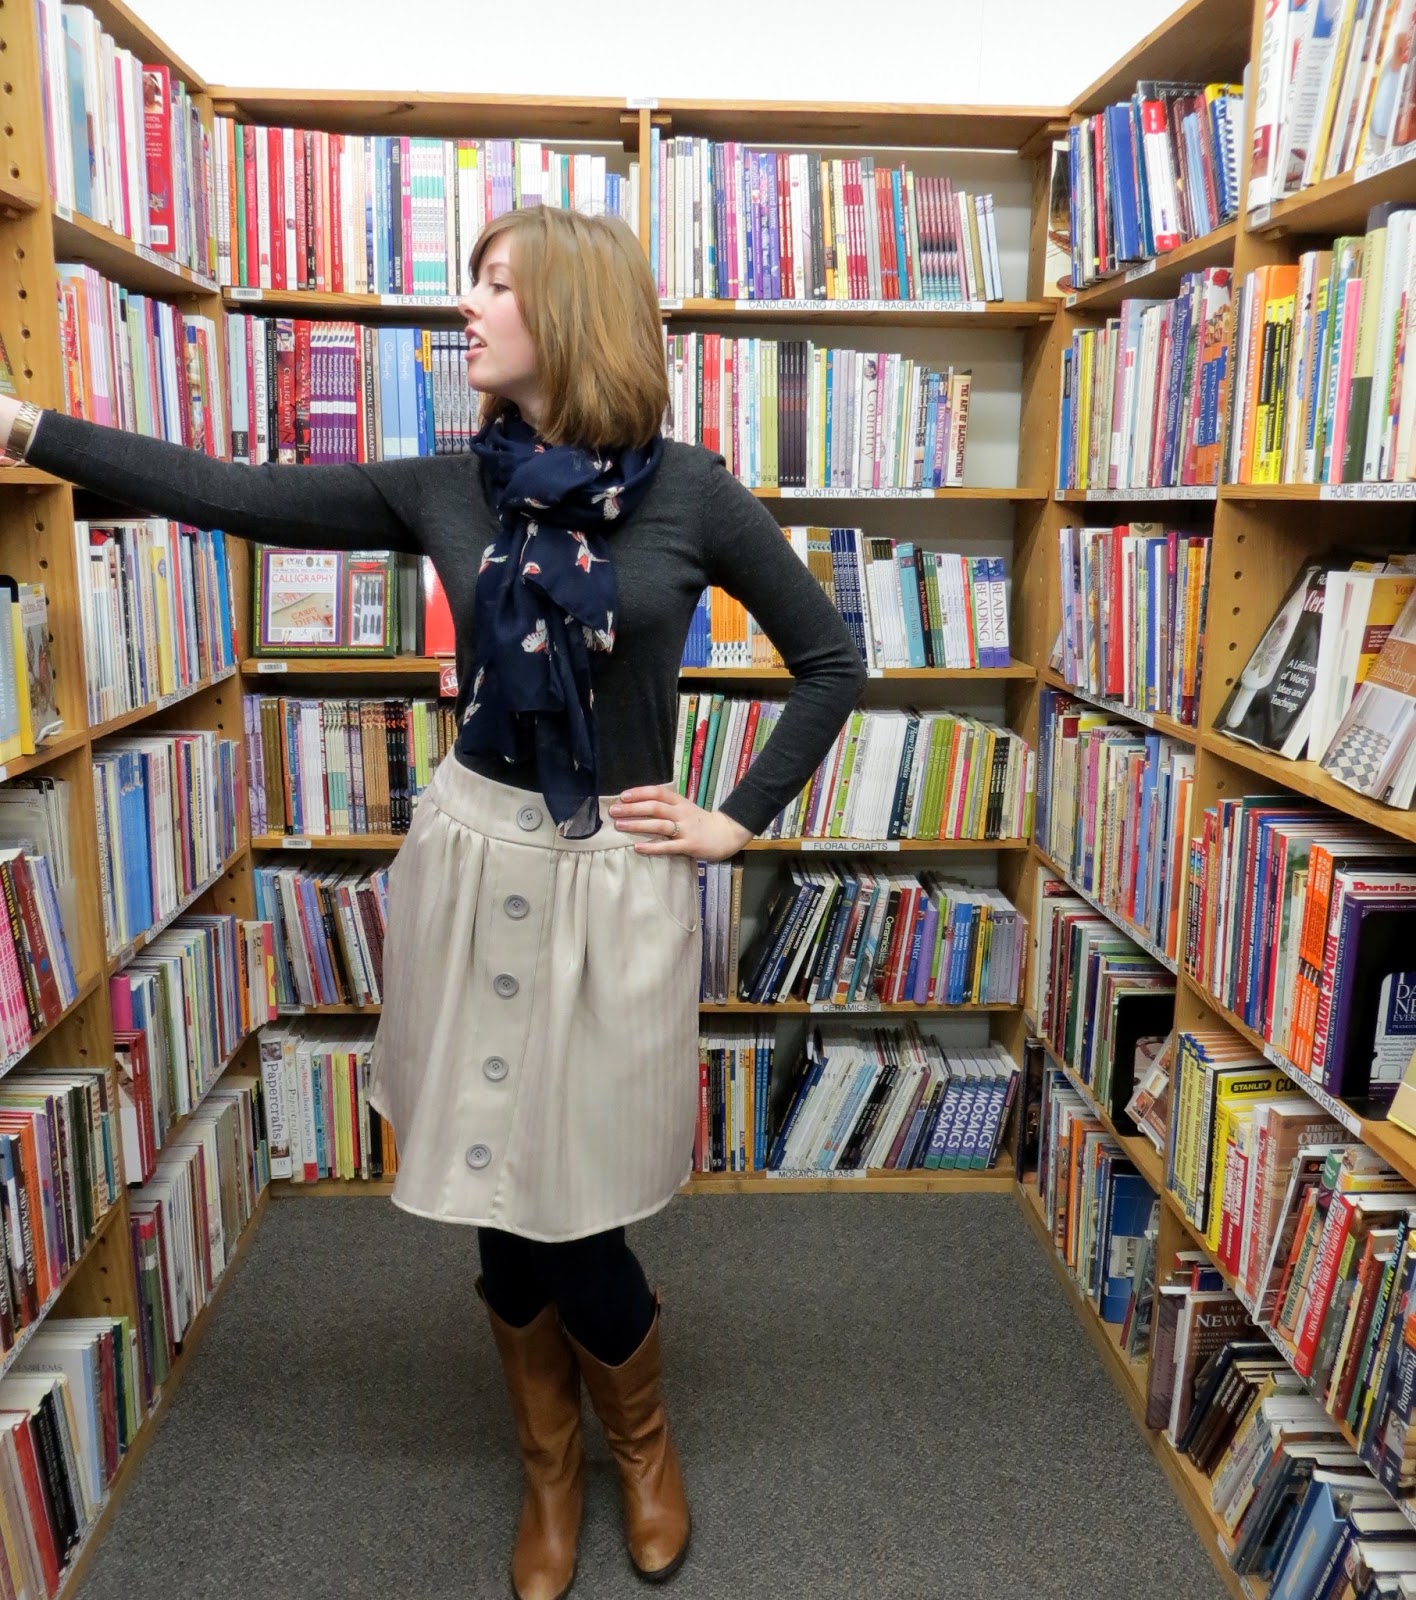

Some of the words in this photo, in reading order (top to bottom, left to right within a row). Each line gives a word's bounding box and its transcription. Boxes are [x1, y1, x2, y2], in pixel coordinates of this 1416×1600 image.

[395, 296, 442, 306] TEXTILES
[748, 301, 827, 311] CANDLEMAKING
[836, 301, 869, 311] SOAPS
[878, 301, 931, 311] FRAGRANT
[933, 301, 973, 311] CRAFTS
[1231, 290, 1240, 333] BEYOND
[1274, 326, 1282, 349] Home
[382, 341, 394, 381] Calligraphy
[400, 341, 412, 381] Calligraphy
[1260, 351, 1269, 402] Improvement
[254, 350, 265, 431] CALLIGRAPHY
[452, 370, 460, 390] Chinese
[961, 384, 969, 398] THE
[1226, 361, 1235, 426] BUNGALOW
[1269, 351, 1279, 404] Improvement
[1327, 363, 1338, 421] BOOK
[283, 367, 291, 428] CALLIGRAPHY
[433, 393, 442, 425] Calligraphy
[442, 393, 450, 425] Calligraphy
[451, 393, 460, 425] Calligraphy
[460, 393, 469, 425] Calligraphy
[959, 399, 968, 413] ART
[367, 408, 375, 460] CALLIGRAPHY
[861, 389, 877, 460] Country
[959, 414, 967, 423] OF
[1267, 413, 1275, 449] Dummies
[935, 450, 943, 469] FOIL
[955, 424, 966, 478] BLACKSMITHING
[794, 488, 840, 498] COUNTRY
[849, 488, 880, 498] METAL
[883, 488, 922, 498] CRAFTS
[1330, 485, 1355, 499] HOME
[272, 573, 335, 583] CALLIGRAPHY
[975, 582, 990, 642] BEADING
[992, 582, 1006, 642] BEADING
[1280, 671, 1289, 680] of
[1290, 673, 1309, 687] Works,
[1287, 659, 1294, 669] A
[1270, 695, 1298, 713] Teachings
[1276, 684, 1291, 696] Ideas
[1291, 687, 1303, 698] and
[686, 715, 694, 734] GREEN
[684, 736, 692, 753] GIFTS
[902, 746, 914, 779] Domestica
[813, 841, 848, 851] FLORAL
[851, 841, 888, 851] CRAFTS
[1252, 861, 1260, 882] HOME
[25, 889, 44, 954] Needlework
[785, 900, 802, 924] POTTERY
[853, 909, 865, 939] CERAMICS
[1249, 885, 1259, 943] IMPROVEMENT
[1341, 913, 1349, 934] HOW
[772, 924, 792, 960] DECORATION
[849, 939, 859, 956] BIBLE
[879, 916, 894, 952] Ceramics
[911, 934, 923, 960] potter
[824, 943, 841, 981] Ceramics
[1245, 945, 1254, 1003] ENCYCLOPEDIA
[1321, 933, 1338, 993] HOME
[822, 1003, 870, 1012] CERAMICS
[1326, 1009, 1337, 1063] EVERYTHING
[265, 1063, 283, 1139] Papercrafts
[1233, 1081, 1270, 1092] STANLEY
[1272, 1052, 1293, 1078] HOME
[1294, 1070, 1351, 1124] IMPROVEMENT
[931, 1090, 960, 1149] MOSAICS
[947, 1090, 975, 1149] MOSAICS
[962, 1090, 990, 1149] MOSAICS
[978, 1090, 1005, 1149] MOSAICS
[1195, 1096, 1203, 1117] Home
[303, 1119, 311, 1137] Paper
[1191, 1119, 1201, 1169] Woodworking
[305, 1138, 313, 1157] Crafts
[778, 1169, 818, 1179] MOSAICS
[826, 1169, 856, 1179] GLASS
[1237, 1158, 1245, 1178] NEW
[1190, 1172, 1198, 1198] Manual
[1233, 1177, 1243, 1226] COMPLETE
[1327, 1225, 1342, 1268] COMPLETE
[1322, 1267, 1331, 1291] HOME
[1383, 1269, 1395, 1302] PAINT
[1195, 1314, 1235, 1327] NEW
[1308, 1289, 1325, 1342] IMPROVEMENT
[1397, 1349, 1416, 1414] Plumbing
